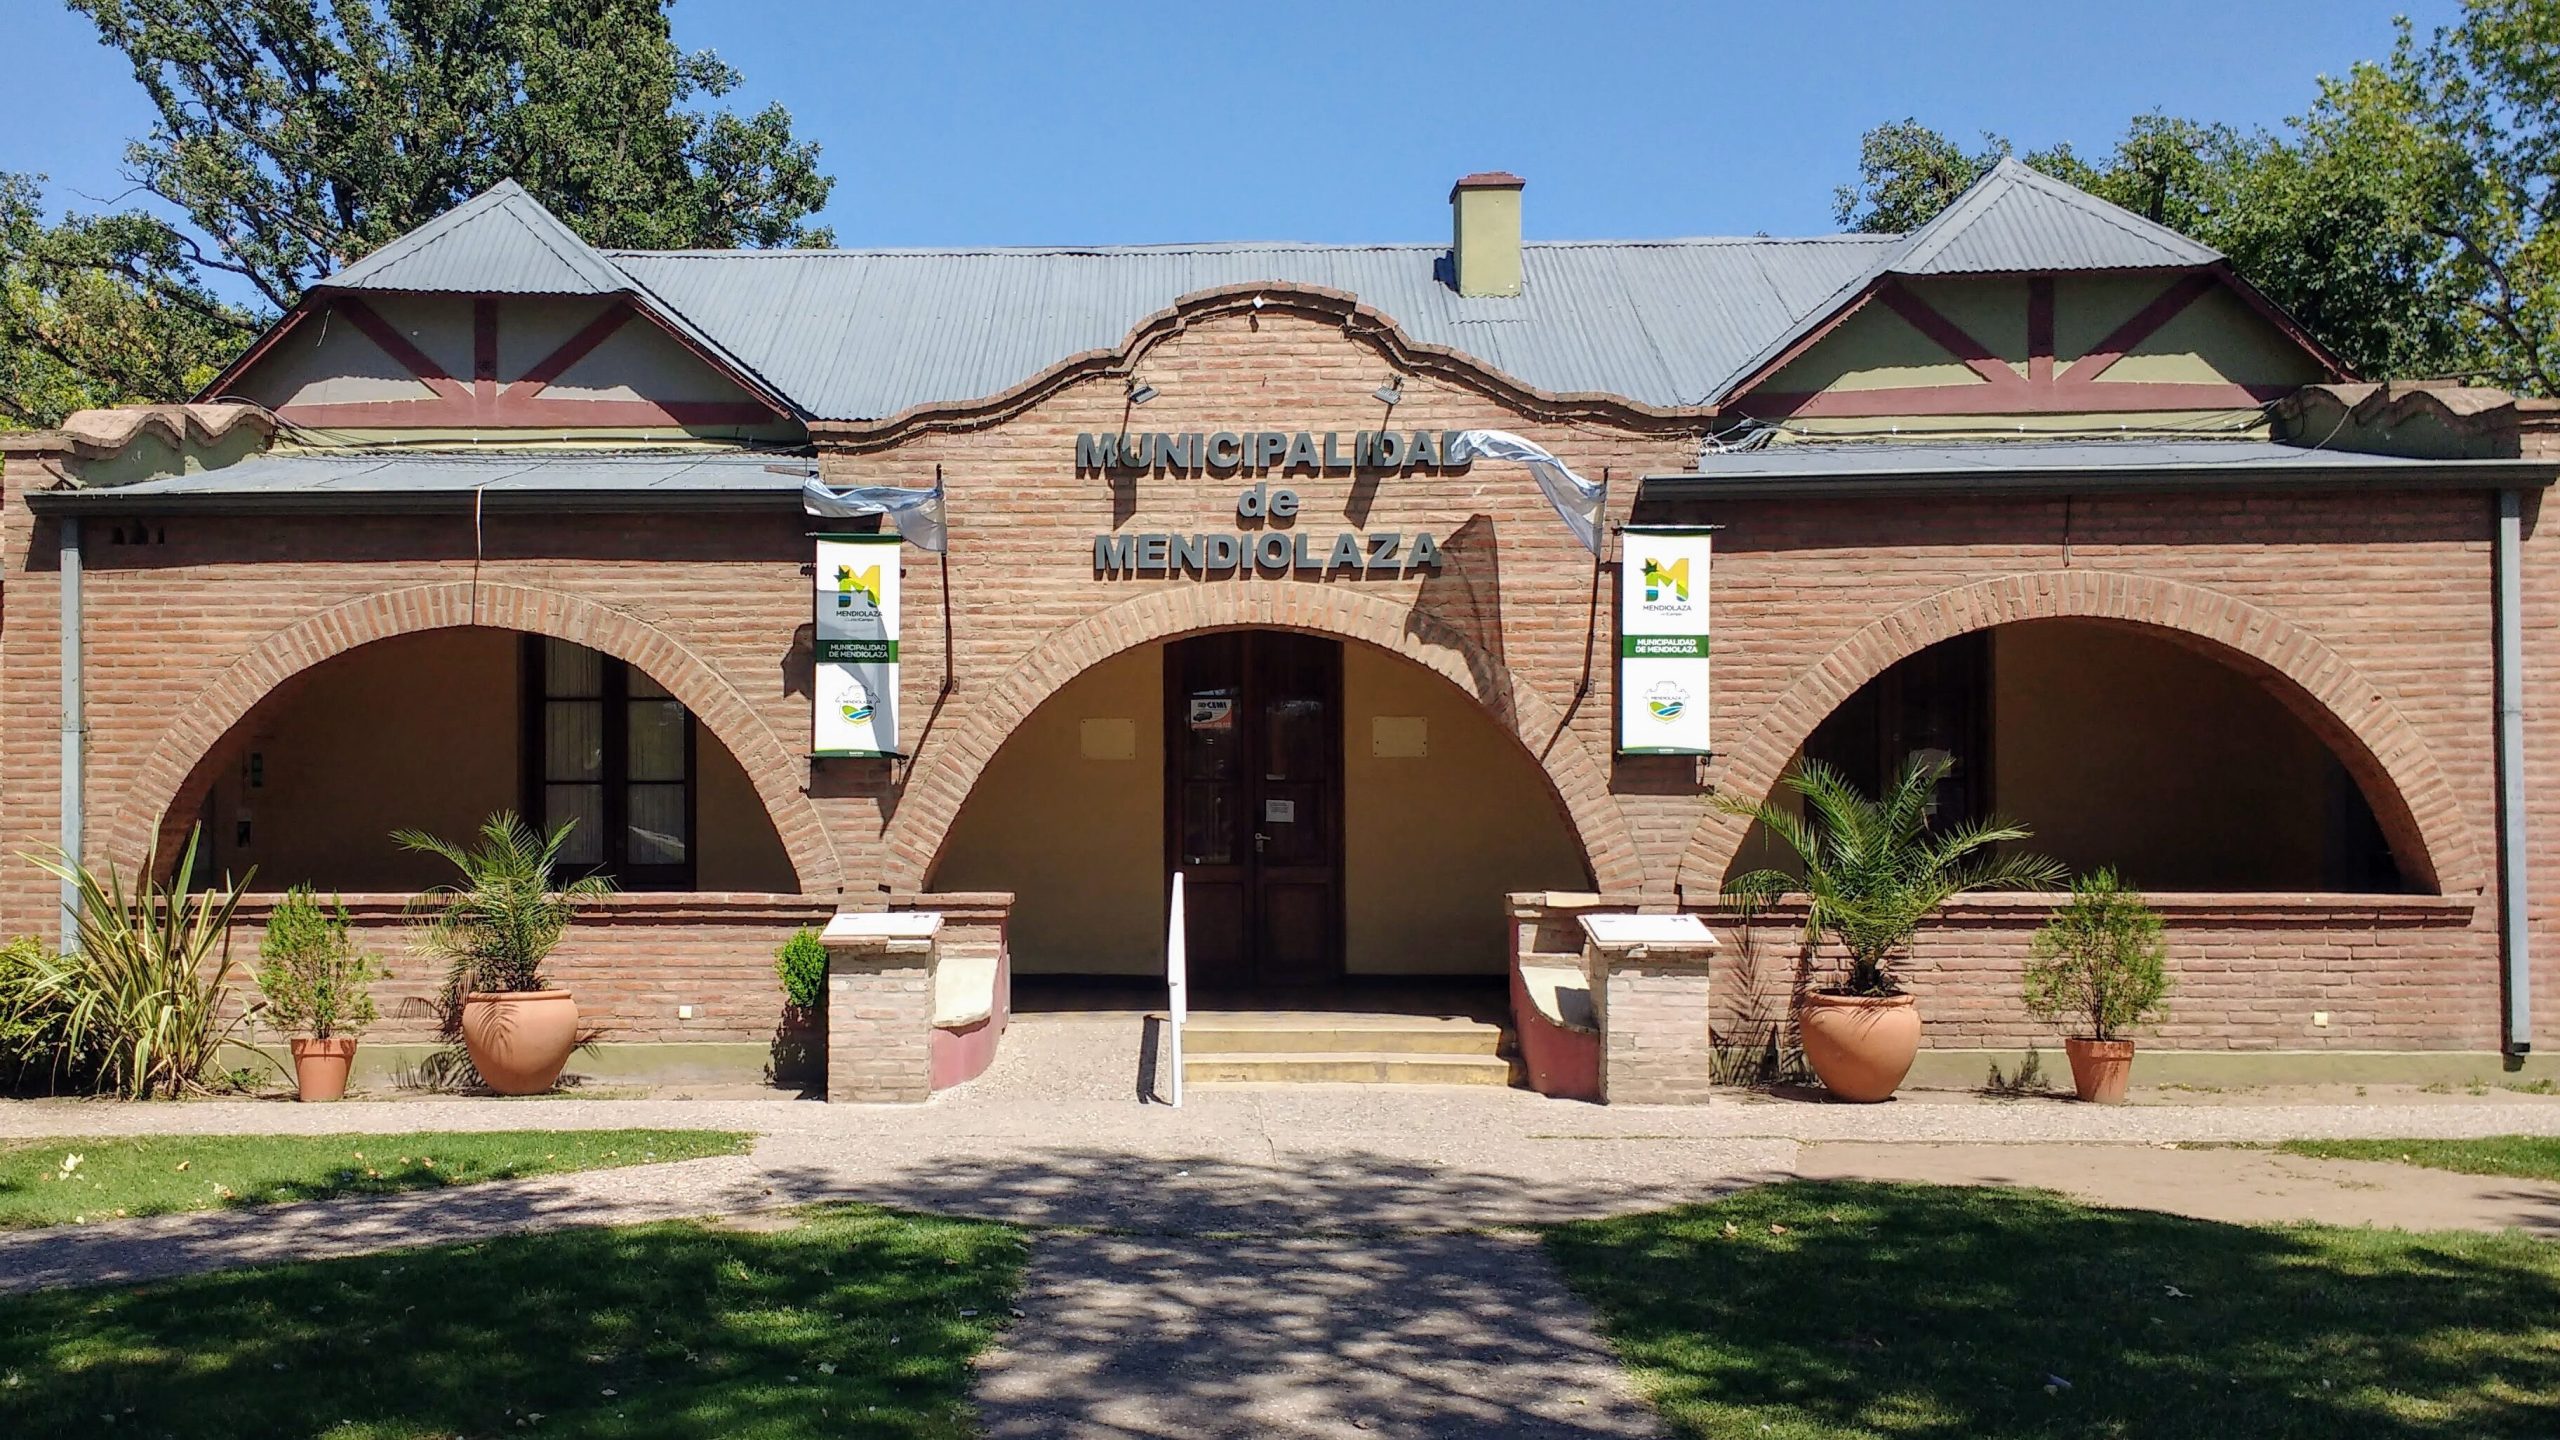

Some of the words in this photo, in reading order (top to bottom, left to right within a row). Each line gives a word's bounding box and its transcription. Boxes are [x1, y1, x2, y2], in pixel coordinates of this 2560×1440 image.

[1077, 431, 1473, 468] MUNICIPALIDAD
[1238, 483, 1299, 518] de
[1095, 533, 1442, 570] MENDIOLAZA
